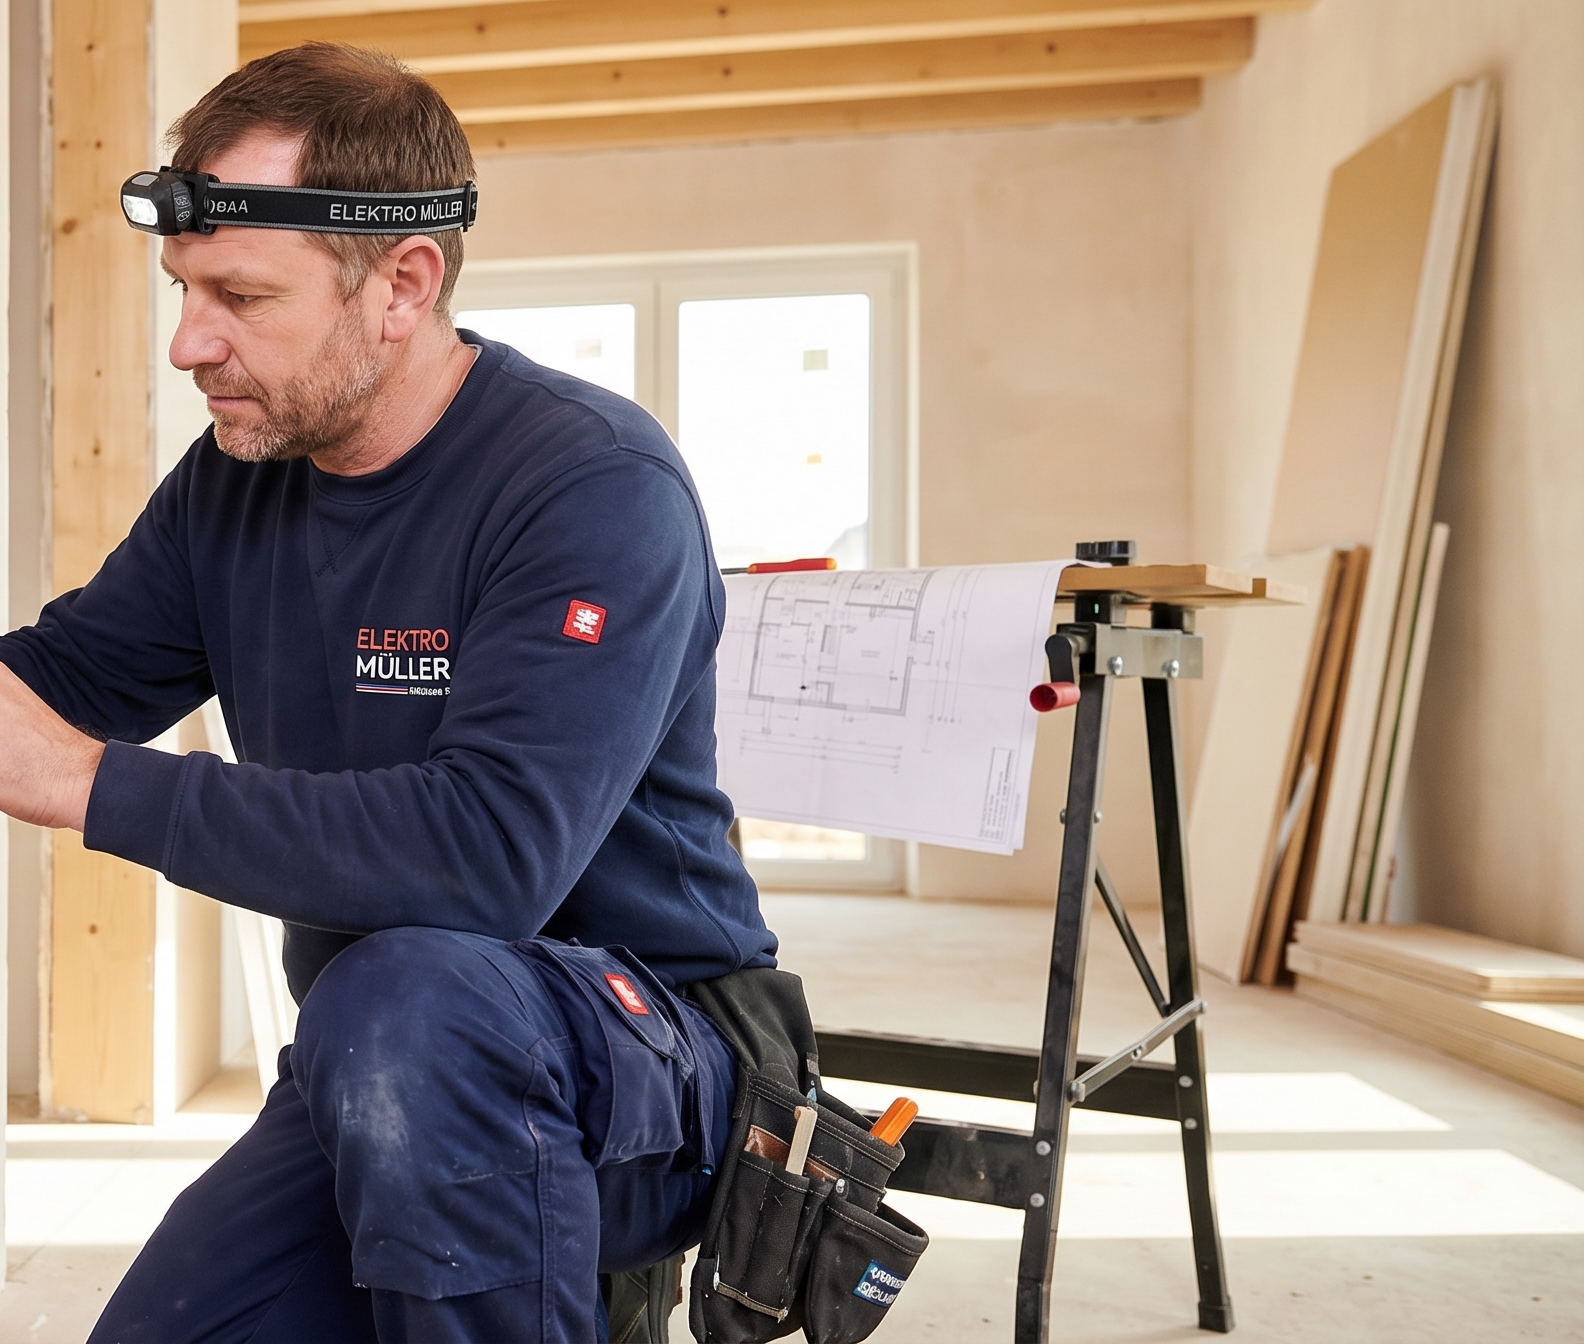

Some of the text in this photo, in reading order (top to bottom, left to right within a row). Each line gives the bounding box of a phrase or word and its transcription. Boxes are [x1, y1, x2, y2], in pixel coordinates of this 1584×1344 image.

[329, 203, 417, 222] ELEKTRO
[357, 628, 449, 651] ELEKTRO
[356, 652, 451, 680] MÜLLER
